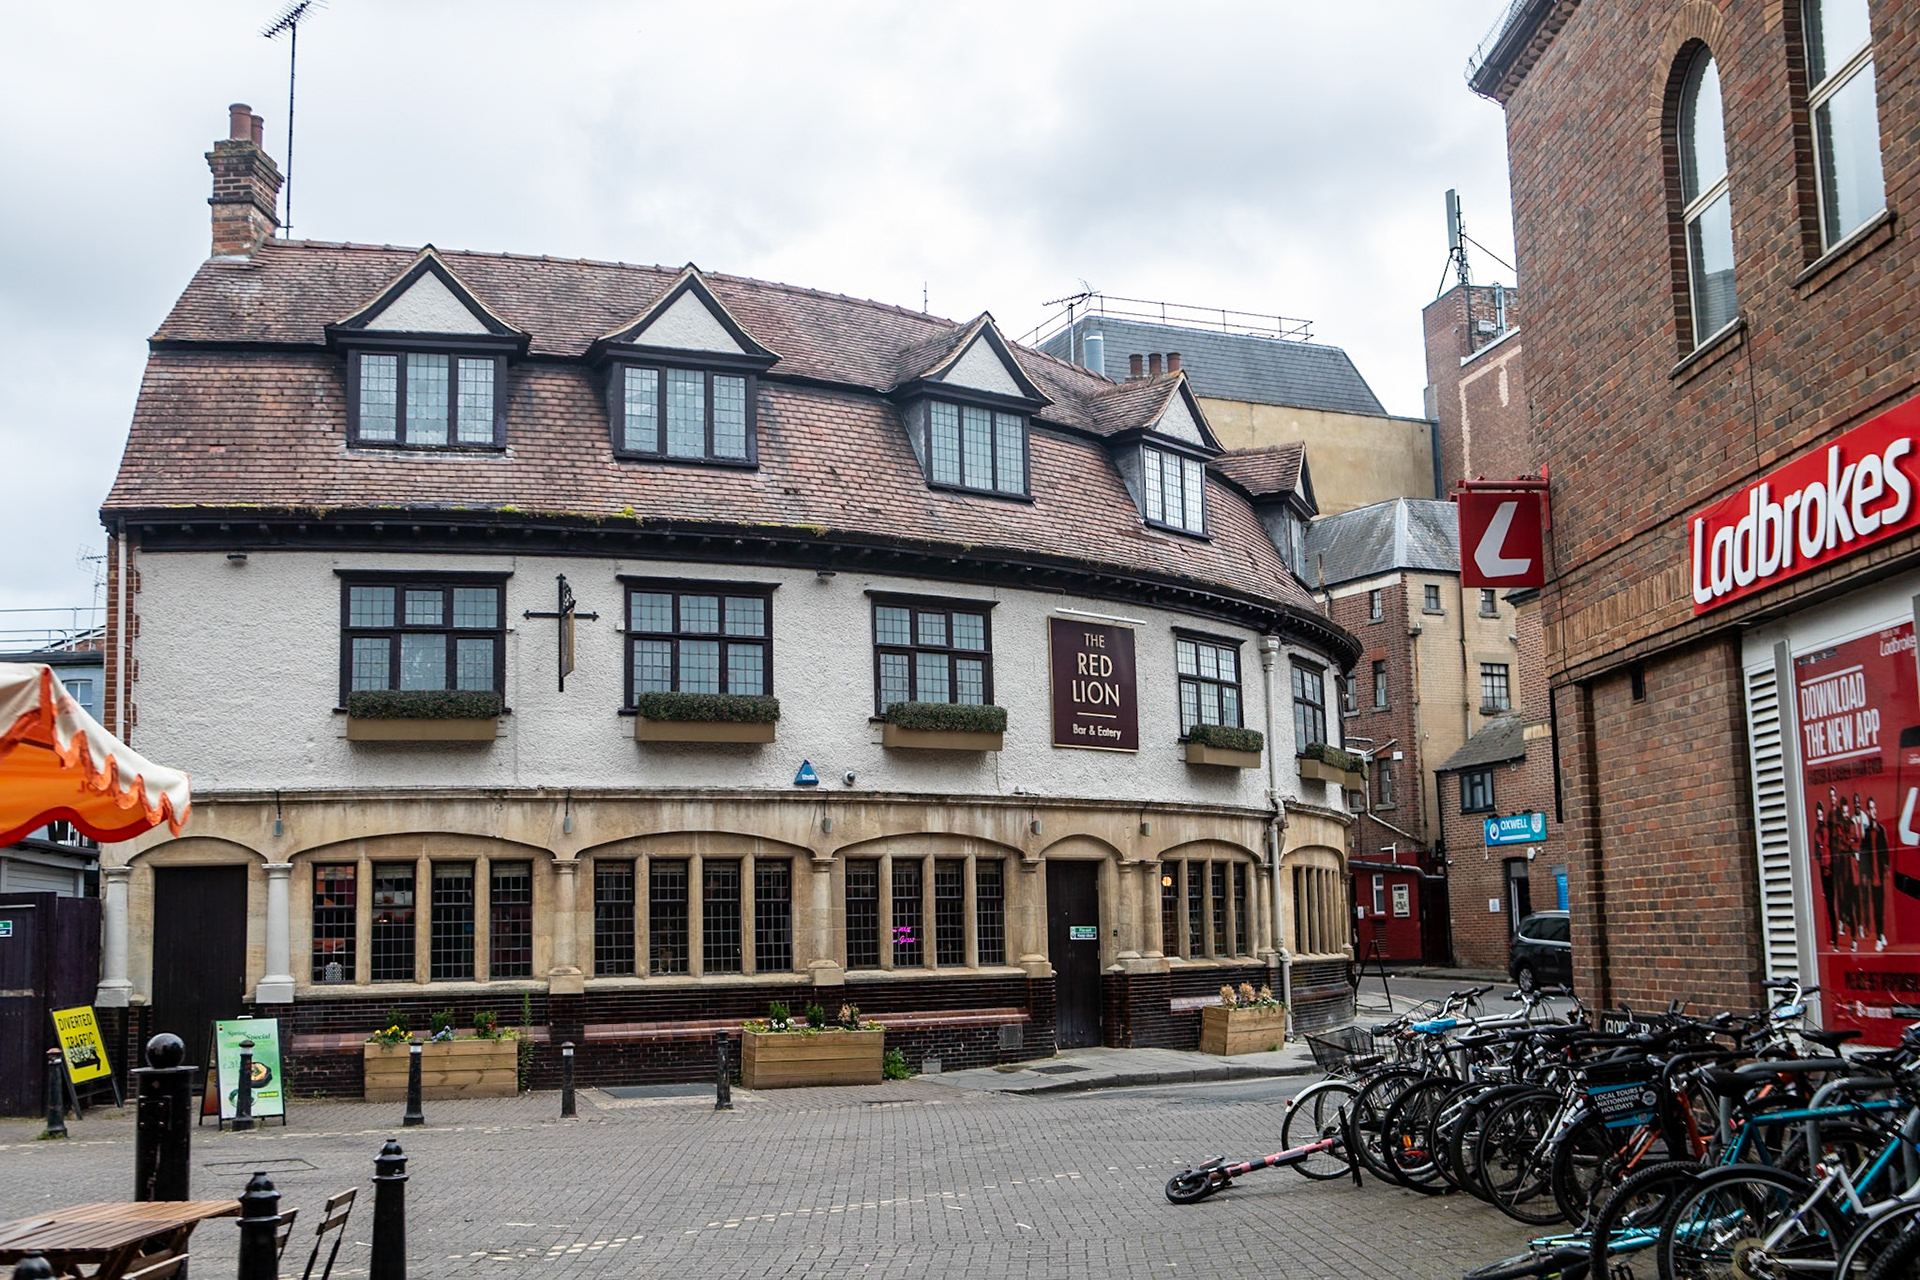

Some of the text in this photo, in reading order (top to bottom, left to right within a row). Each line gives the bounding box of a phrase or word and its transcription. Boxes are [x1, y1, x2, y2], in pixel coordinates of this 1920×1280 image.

[1693, 437, 1911, 604] Ladbrokes
[1083, 633, 1106, 649] THE
[1077, 652, 1113, 677] RED
[1072, 680, 1120, 708] LION
[1800, 672, 1866, 722] DOWNLOAD
[1072, 723, 1122, 741] Bar & Eatery
[1803, 708, 1880, 758] THE NEW APP
[1500, 818, 1528, 831] OXWELL
[57, 1012, 93, 1031] DIVERTED
[65, 1031, 95, 1049] TRAFFIC
[1594, 1091, 1615, 1102] LOCAL
[1616, 1087, 1639, 1097] TOURS
[1597, 1094, 1640, 1108] NATIONWIDE
[1601, 1102, 1634, 1114] HOLIDAYS
